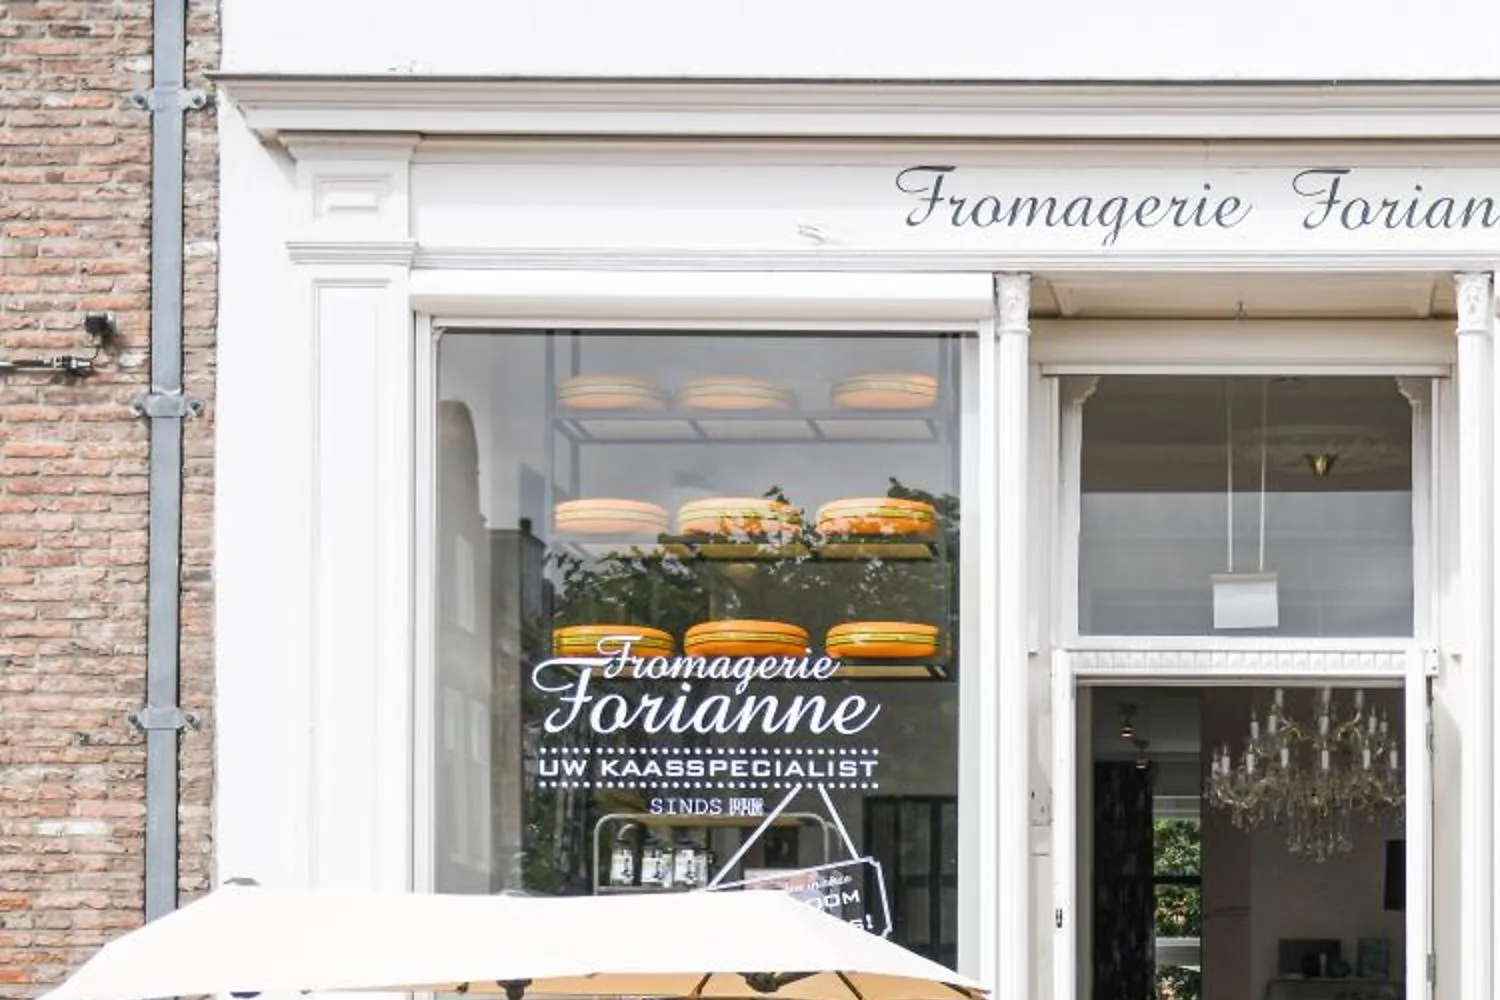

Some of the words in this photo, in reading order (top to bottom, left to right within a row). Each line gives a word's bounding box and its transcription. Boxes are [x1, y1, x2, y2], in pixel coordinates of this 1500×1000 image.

[896, 164, 1252, 247] Fromagerie
[597, 635, 842, 695] Fromagerie
[532, 658, 881, 735] Forianne
[539, 760, 588, 777] UW
[600, 759, 879, 777] KAASSPECIALIST
[650, 797, 722, 815] SINDS
